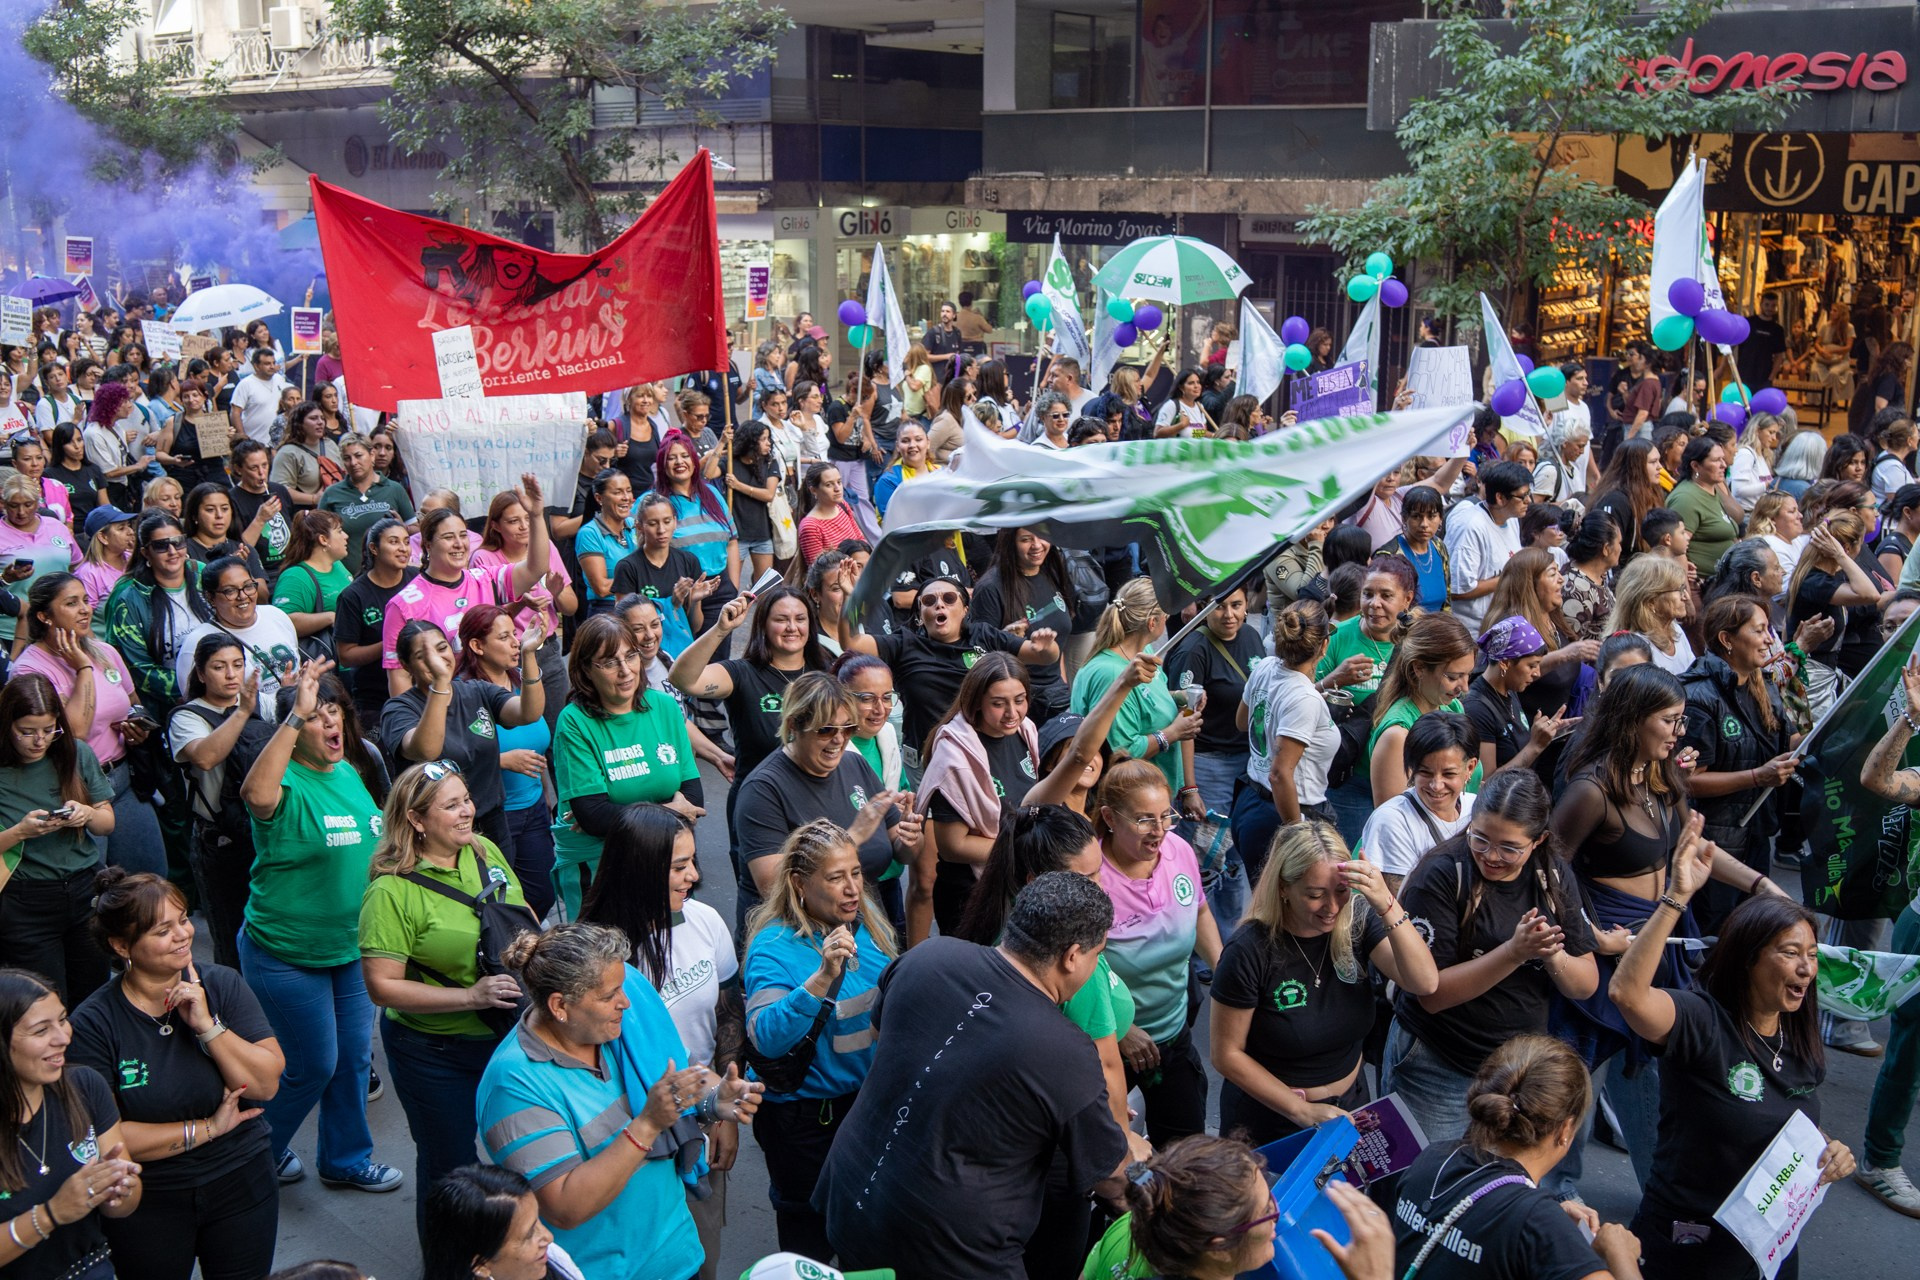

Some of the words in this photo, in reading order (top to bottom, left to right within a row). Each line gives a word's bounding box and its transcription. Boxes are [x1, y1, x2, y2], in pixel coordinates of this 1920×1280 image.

[1617, 37, 1907, 98] ndonesia
[781, 216, 809, 230] Glikó
[839, 211, 892, 236] Glikó
[945, 210, 981, 229] Glikó
[1023, 215, 1050, 235] Via
[1055, 217, 1112, 237] Morino
[1114, 219, 1162, 240] Joyas
[1251, 219, 1297, 234] EDIFICI
[471, 302, 628, 376] Berkins
[481, 367, 551, 388] orriente
[556, 351, 626, 377] Nacional
[1291, 376, 1314, 405] ME
[466, 408, 484, 424] AL
[500, 405, 581, 422] AJUSTE
[608, 761, 650, 781] SURRBAC
[326, 831, 362, 847] SURRBAC
[1368, 1131, 1387, 1157] AUNQUE
[1382, 1154, 1392, 1164] LO
[1374, 1128, 1390, 1149] LUCHA
[1363, 1134, 1381, 1157] TENGAS
[1376, 1155, 1390, 1174] TODO
[1365, 1146, 1381, 1170] TODAS
[1767, 1247, 1777, 1262] NI
[1777, 1231, 1791, 1246] UN
